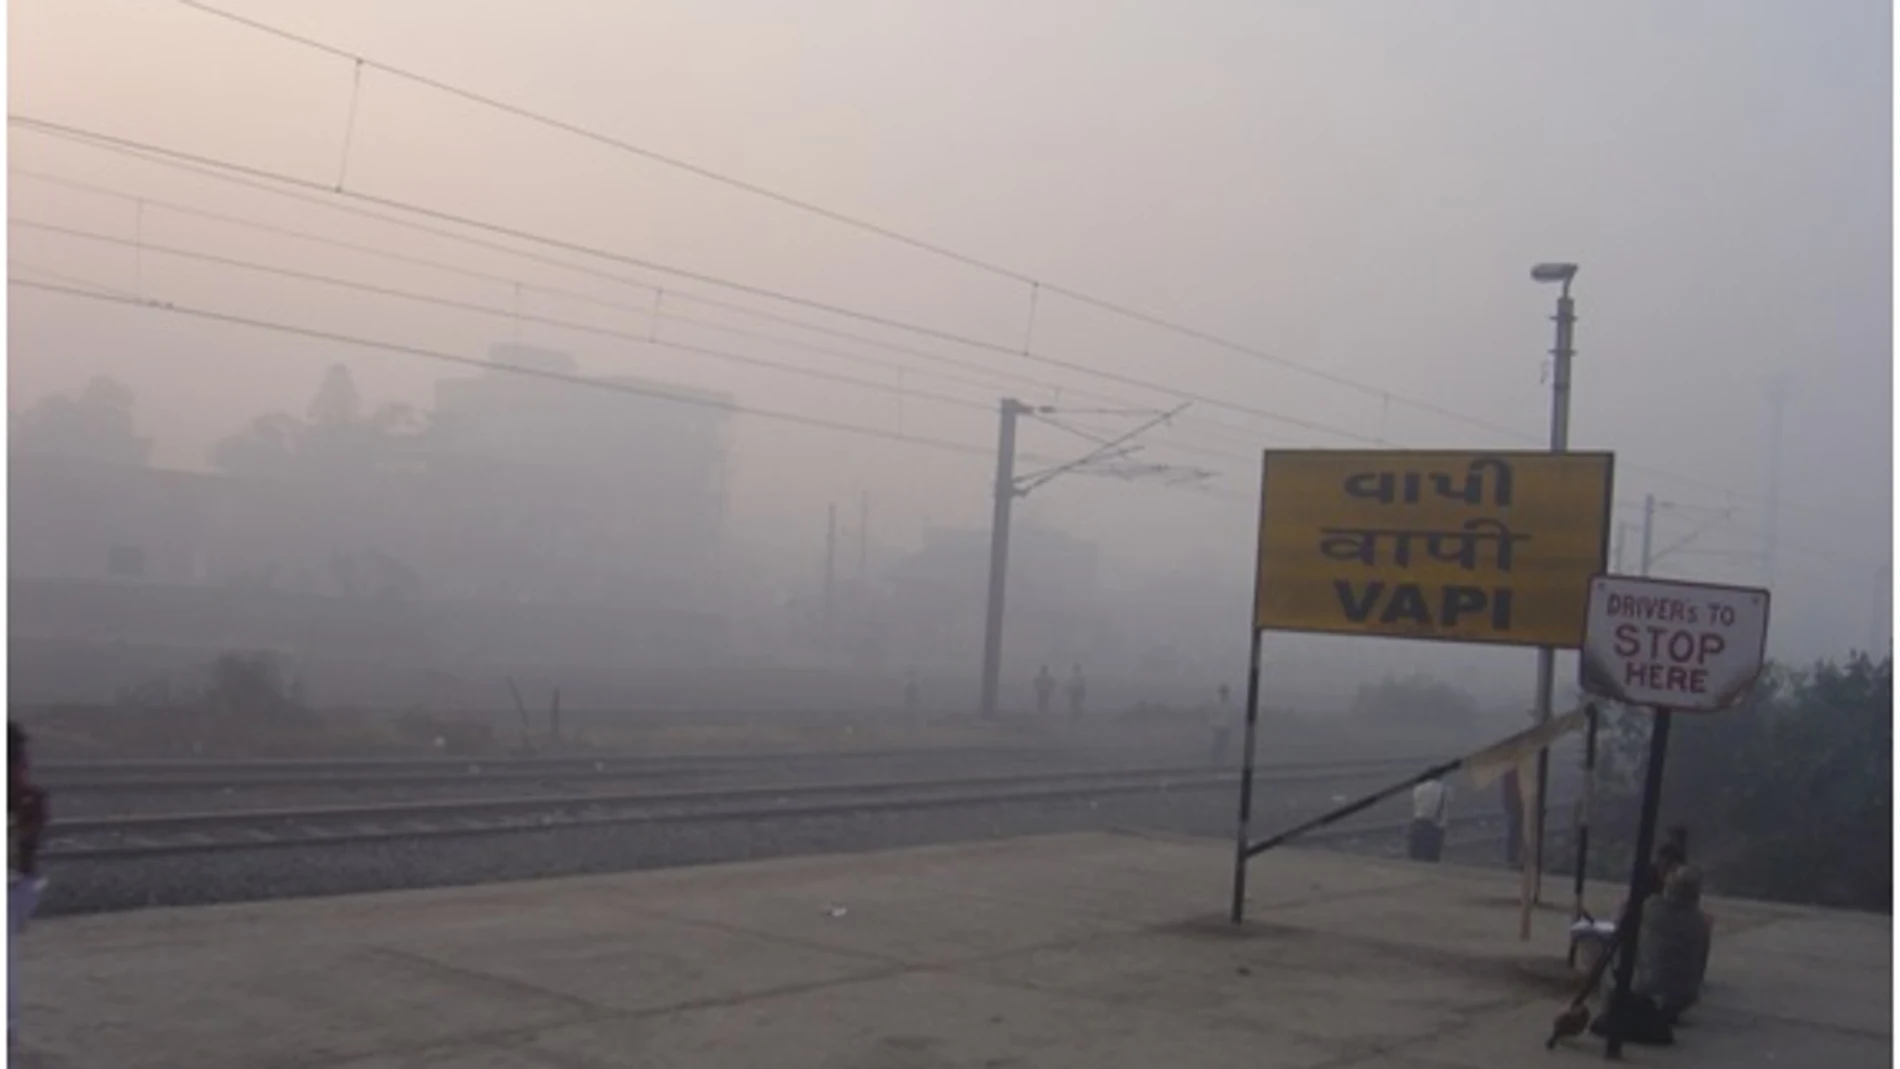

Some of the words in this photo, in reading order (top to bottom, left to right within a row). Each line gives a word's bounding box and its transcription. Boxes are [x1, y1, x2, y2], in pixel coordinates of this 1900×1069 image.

[1345, 459, 1514, 507] વાપી
[1320, 519, 1531, 572] वापी
[1333, 581, 1513, 630] VAPI
[1708, 603, 1735, 627] TO
[1614, 624, 1726, 665] STOP
[1625, 662, 1709, 693] HERE
